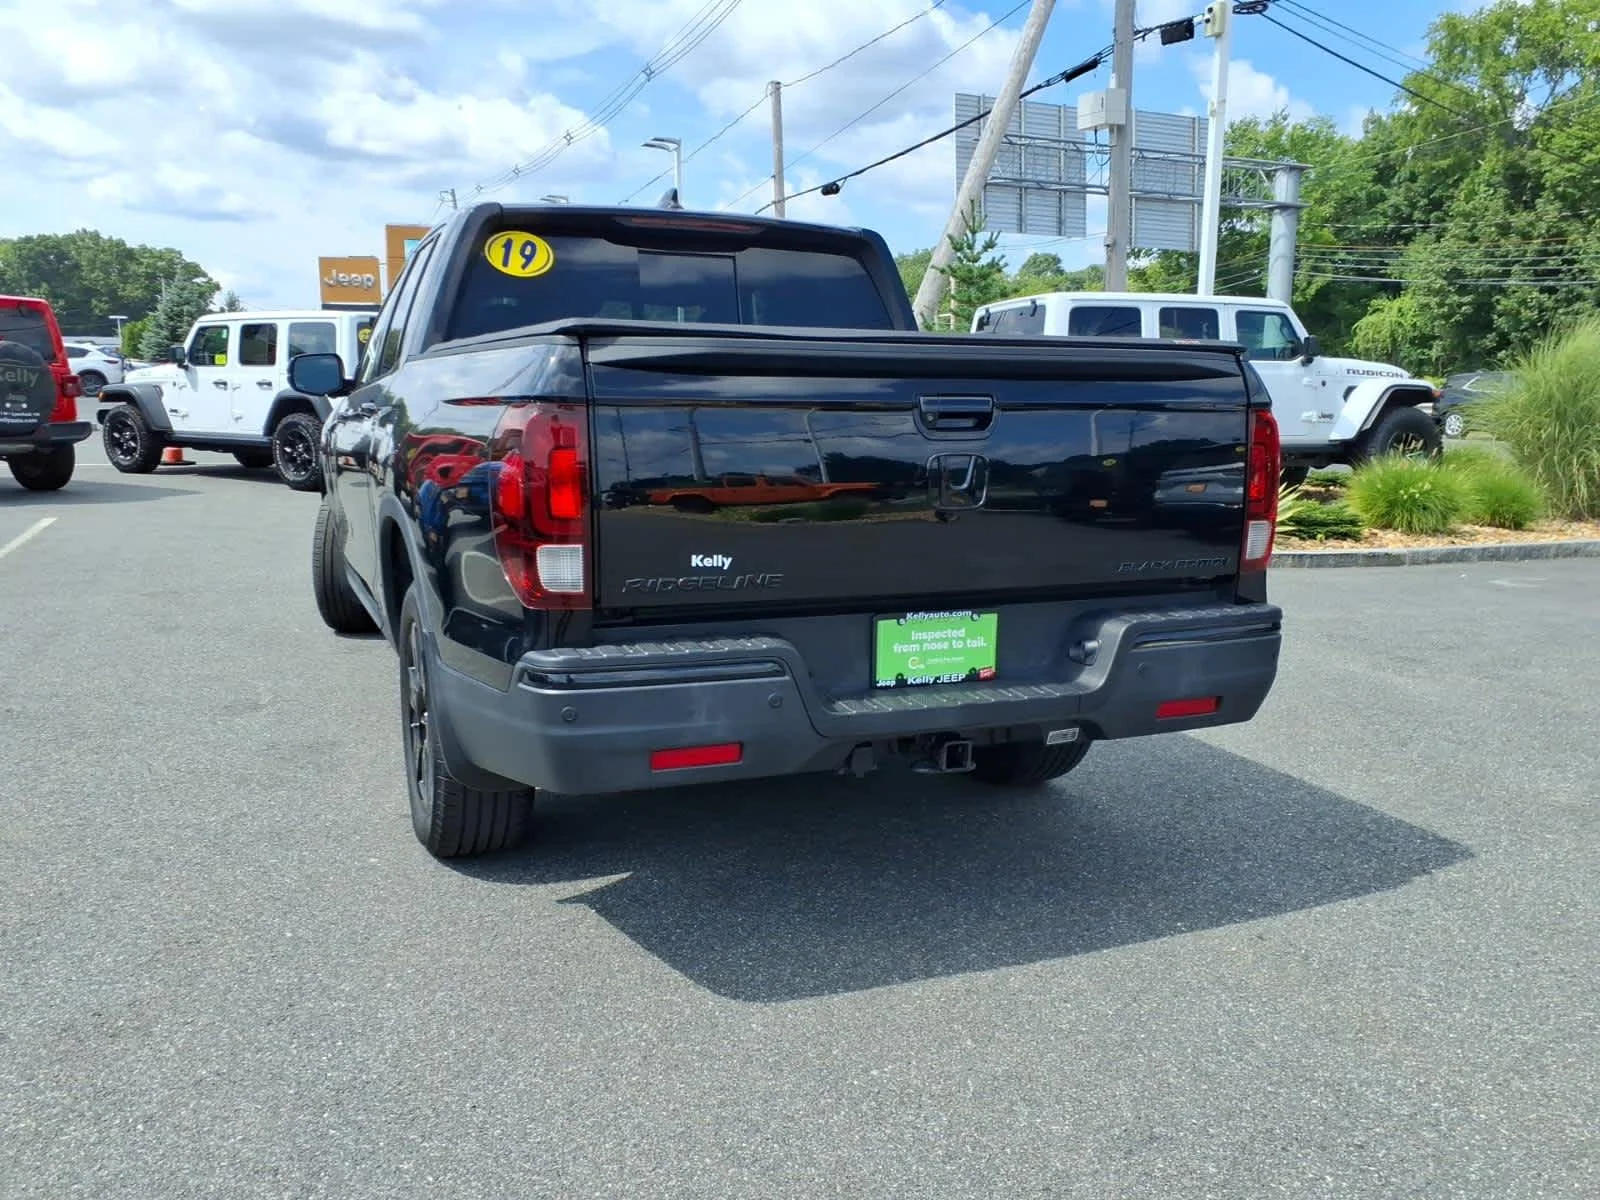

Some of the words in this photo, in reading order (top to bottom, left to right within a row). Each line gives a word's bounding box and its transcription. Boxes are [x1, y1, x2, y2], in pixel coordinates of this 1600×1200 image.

[502, 237, 538, 271] 19
[323, 268, 376, 292] Jeep
[1346, 368, 1404, 378] RUBICON
[690, 554, 732, 570] Kelly
[621, 573, 784, 593] RIDGELINE
[906, 611, 972, 620] Kellyauto.com
[911, 627, 966, 641] Inspected
[893, 642, 920, 653] from
[922, 640, 949, 651] nose
[951, 638, 963, 649] to
[907, 674, 935, 686] Kelly
[936, 673, 966, 684] JEEP
